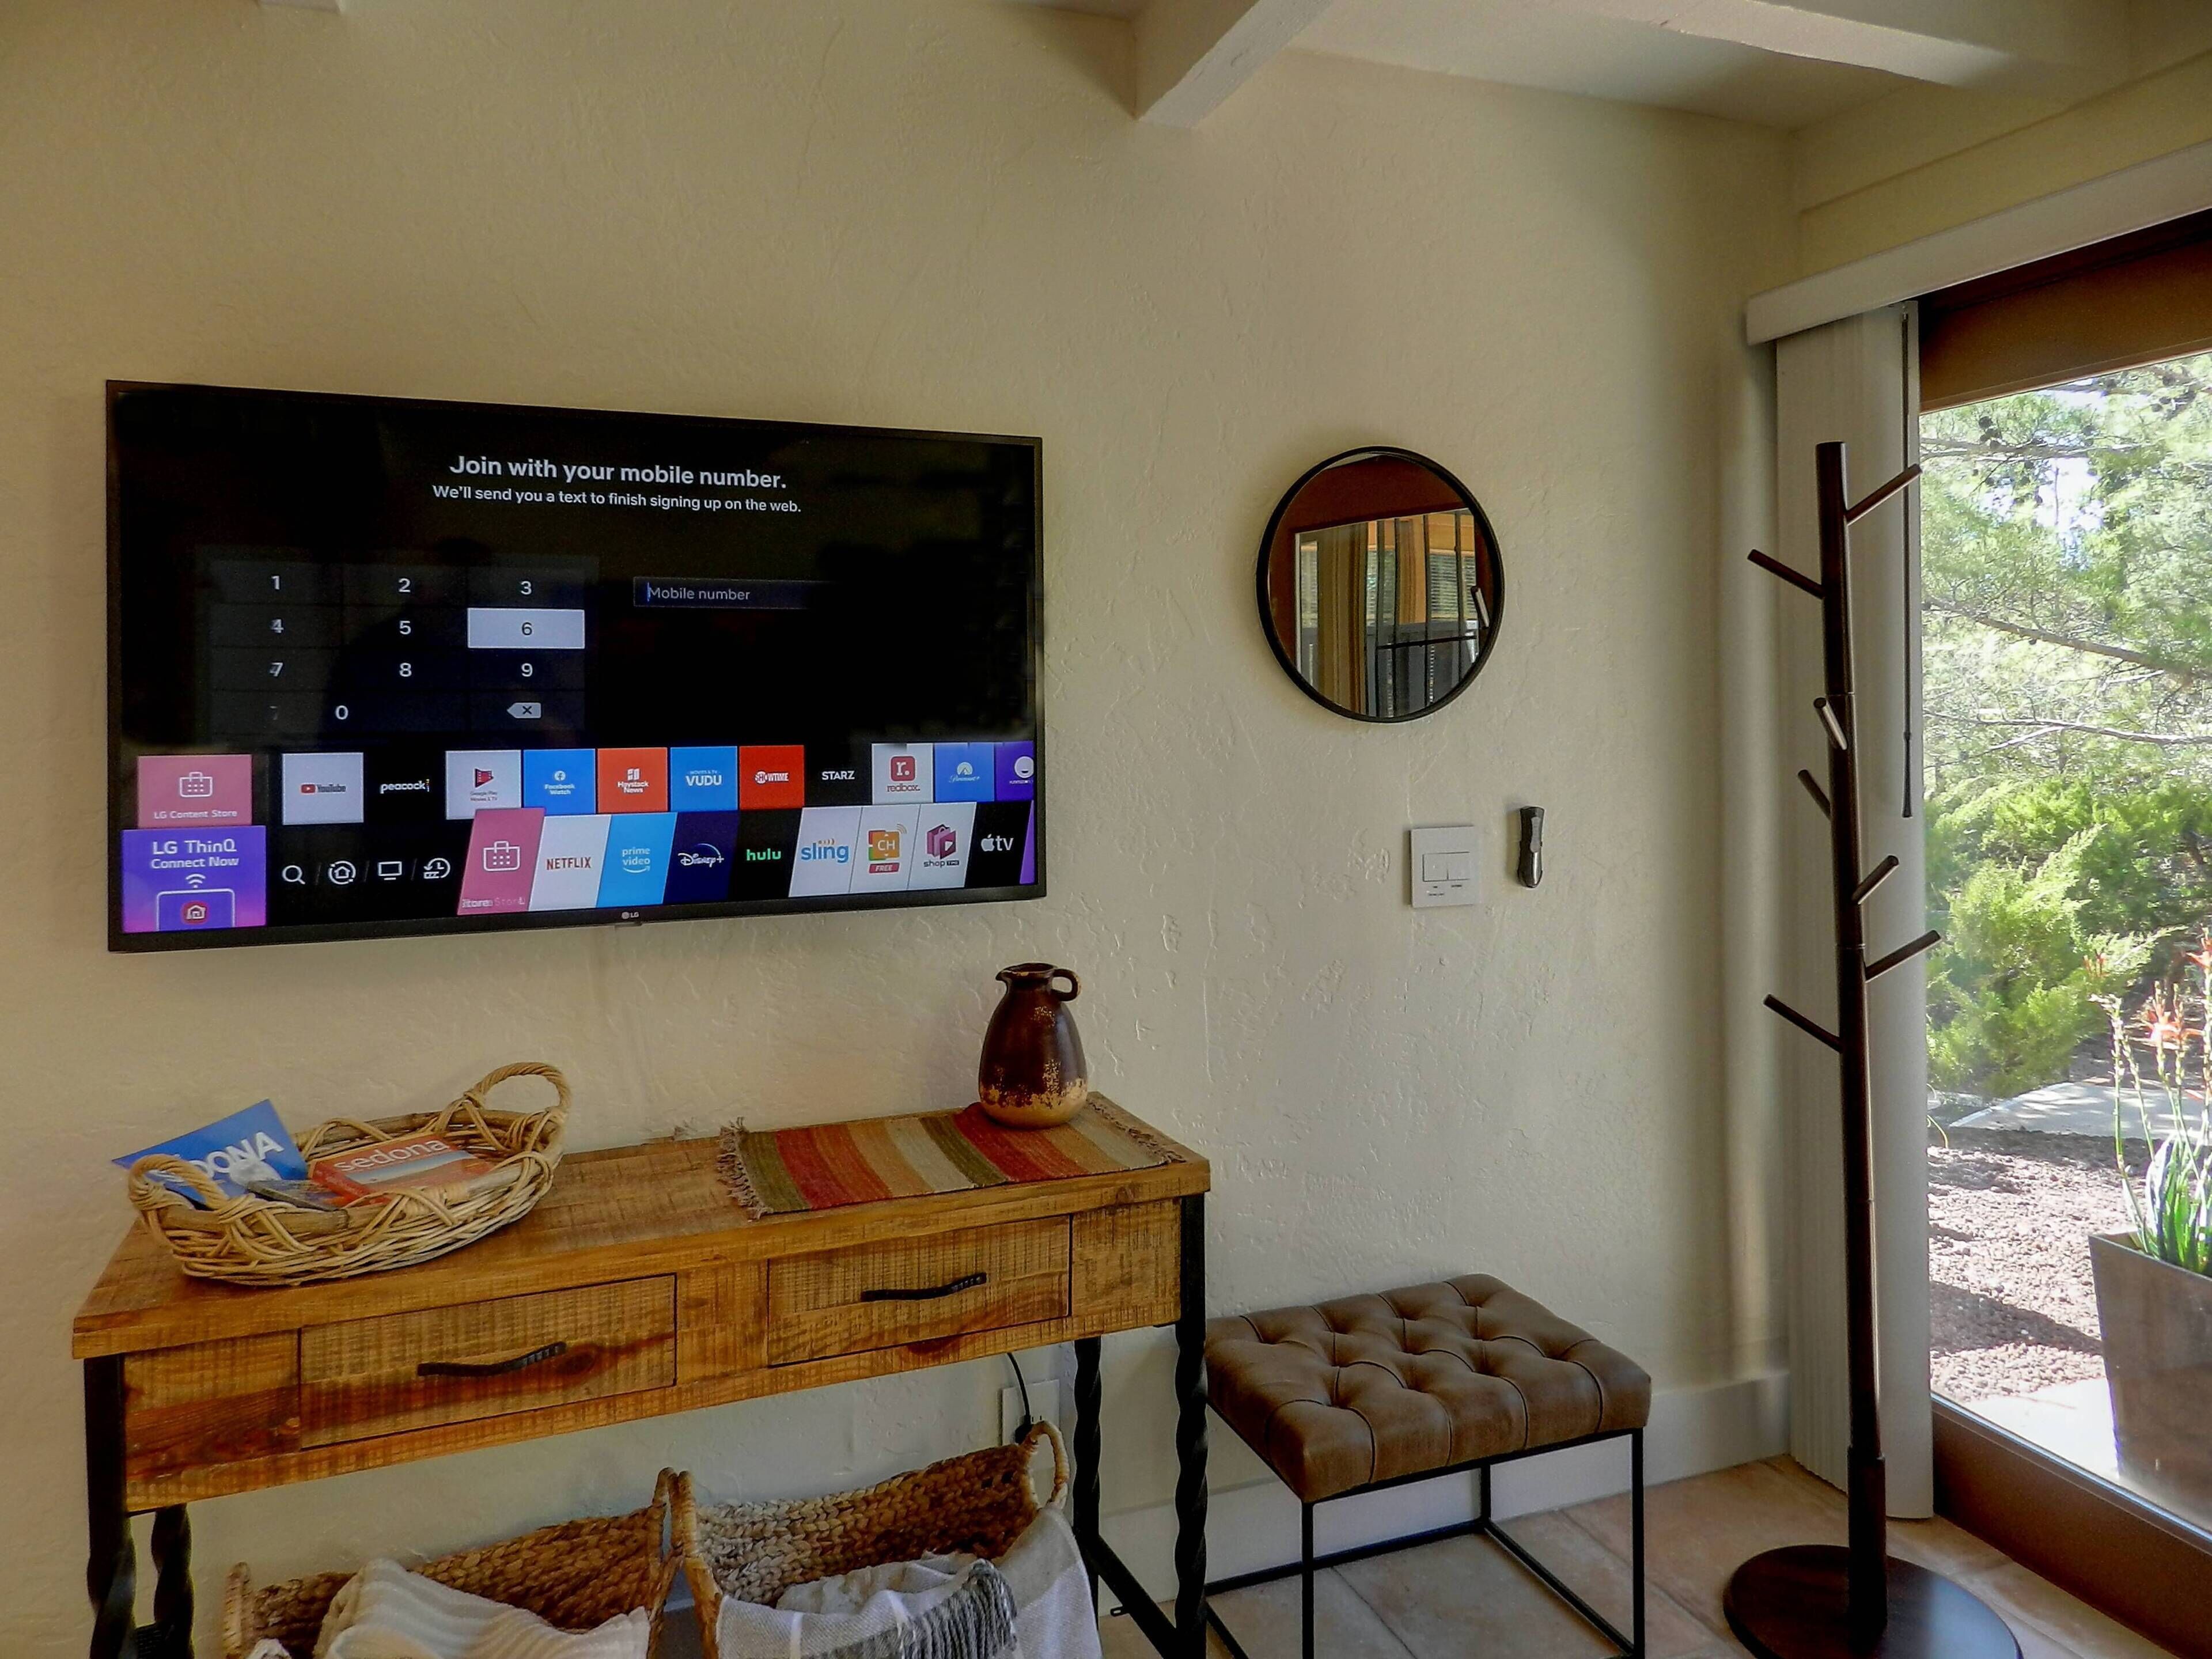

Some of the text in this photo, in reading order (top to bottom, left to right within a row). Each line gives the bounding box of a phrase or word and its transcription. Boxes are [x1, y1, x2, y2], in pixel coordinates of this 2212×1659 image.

[449, 456, 786, 488] Join with your mobile number.
[432, 485, 801, 512] We'll send you a text to finish signing up on the web.
[271, 575, 280, 590] 1
[398, 578, 411, 593] 2
[520, 581, 532, 595] 3
[649, 587, 751, 600] Mobile number
[271, 619, 283, 633] 4
[399, 621, 411, 635] 5
[521, 622, 532, 636] 6
[270, 662, 283, 676] 7
[399, 663, 412, 677] 8
[521, 663, 533, 677] 9
[335, 705, 348, 720] 0
[685, 774, 722, 786] VUDU
[755, 771, 789, 784] SHOWTIME
[821, 771, 855, 780] STARZ
[380, 781, 426, 794] peacock
[154, 809, 238, 819] LG Content Store
[153, 838, 237, 854] LG ThinQ
[877, 840, 895, 851] CH
[997, 836, 1014, 851] tv
[622, 846, 651, 857] prime
[746, 848, 782, 861] hulu
[801, 842, 849, 863] sling
[151, 857, 240, 869] Connect Now
[547, 857, 592, 871] NETFLIX
[623, 857, 651, 865] video
[923, 859, 945, 868] shop
[334, 1139, 450, 1172] sedona
